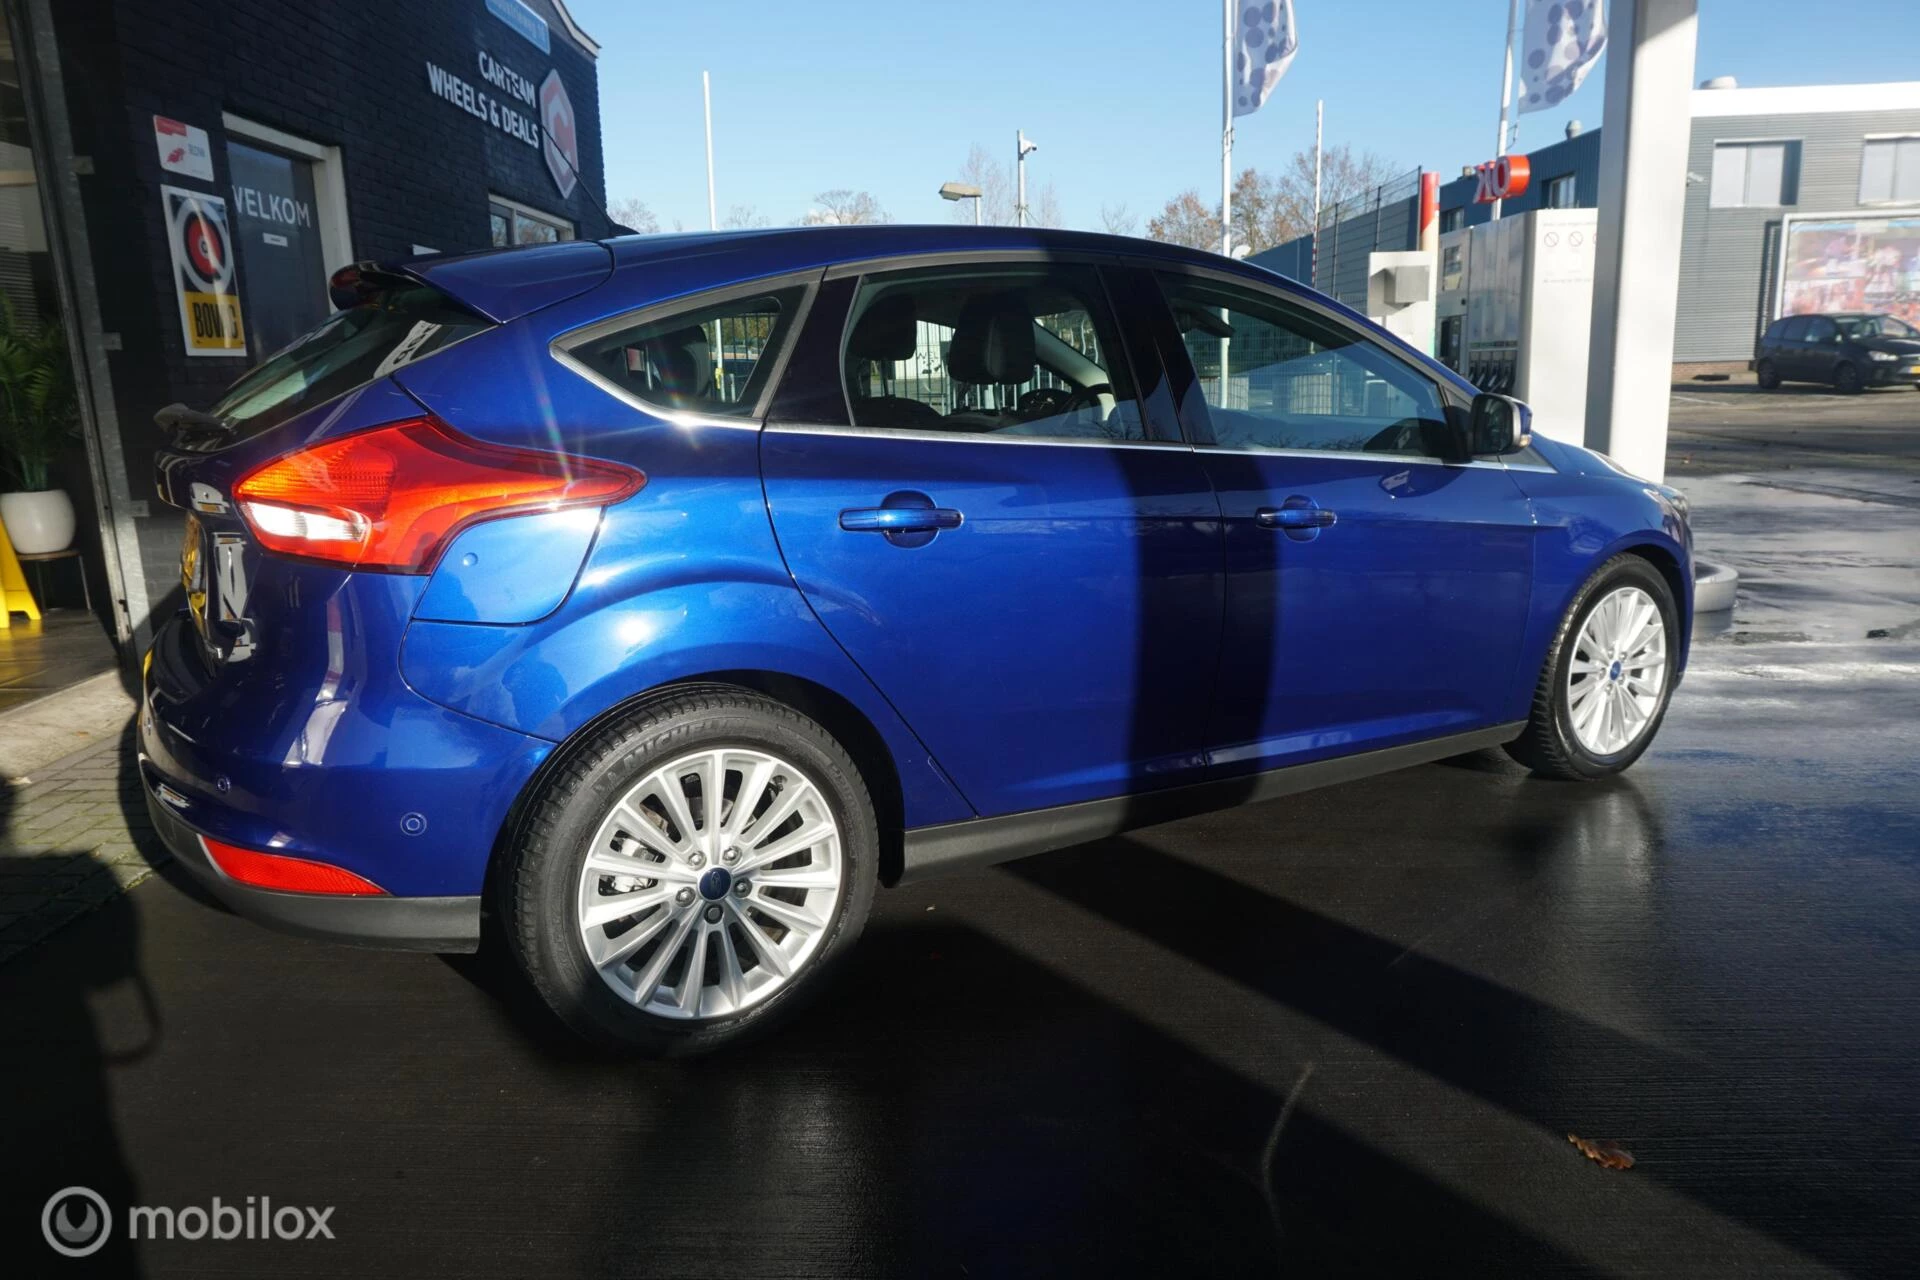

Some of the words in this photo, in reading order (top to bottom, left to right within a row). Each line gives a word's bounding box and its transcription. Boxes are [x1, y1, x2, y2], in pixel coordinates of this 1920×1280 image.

[426, 61, 488, 122] WHEELS
[490, 100, 501, 128] &
[502, 105, 540, 149] DEALS
[478, 51, 537, 109] CARTEAM
